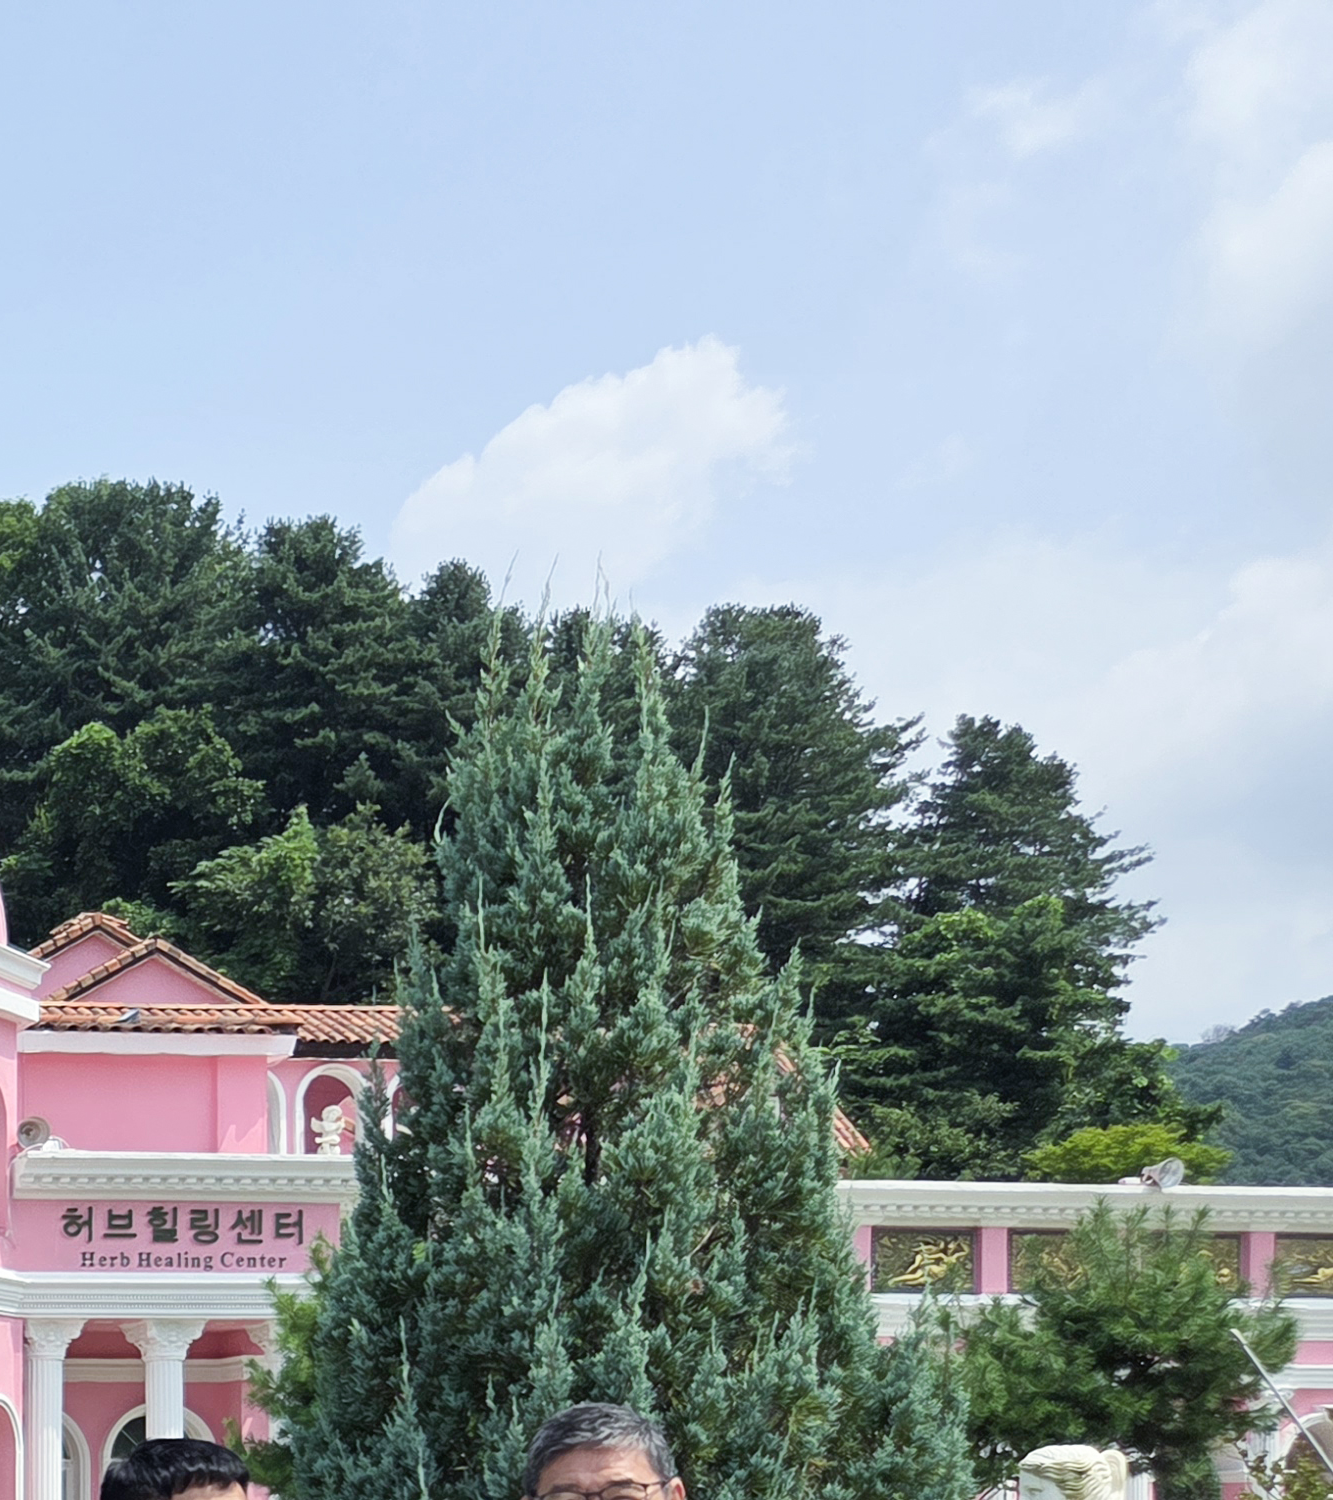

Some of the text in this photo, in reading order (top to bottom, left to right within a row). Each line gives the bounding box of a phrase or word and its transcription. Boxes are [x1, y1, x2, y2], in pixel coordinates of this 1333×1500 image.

[61, 1205, 304, 1246] 허브힐링센터
[80, 1251, 287, 1272] Herb Healing Center
